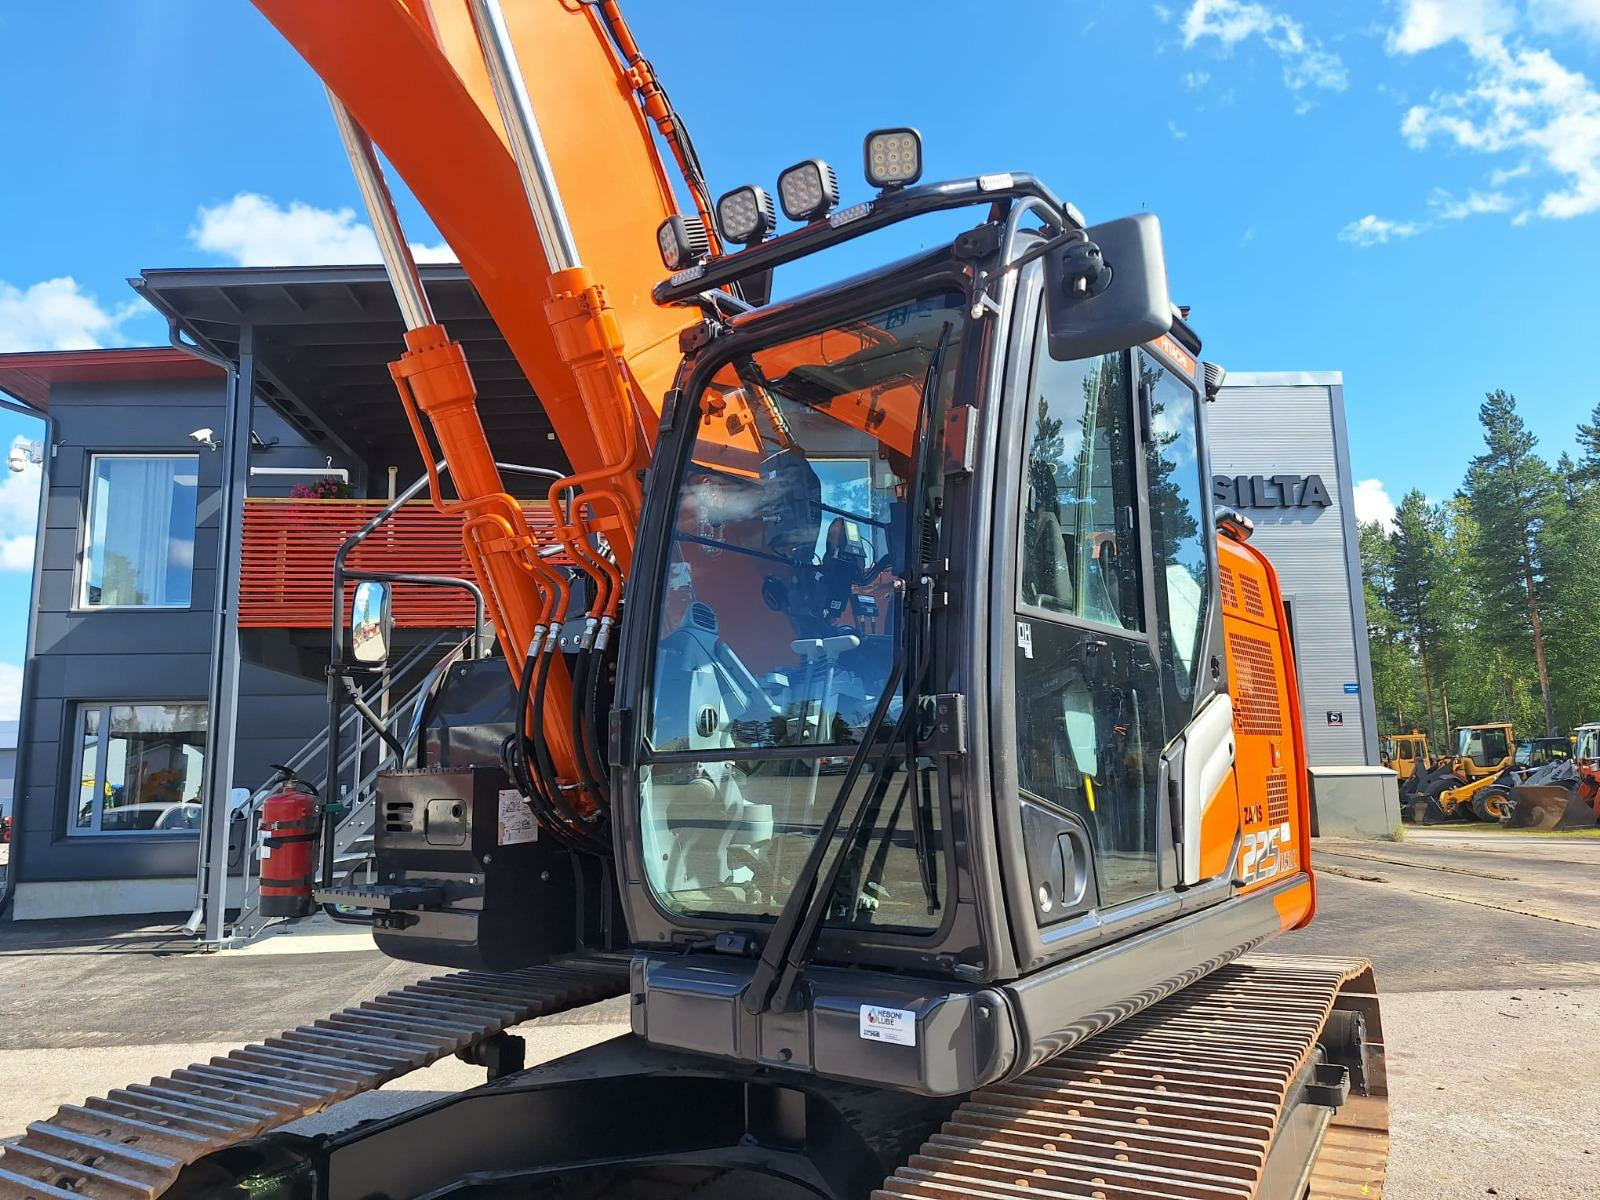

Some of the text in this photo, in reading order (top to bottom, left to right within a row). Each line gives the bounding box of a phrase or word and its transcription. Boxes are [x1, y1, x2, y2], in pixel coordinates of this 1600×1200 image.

[1161, 336, 1188, 368] HITACHI
[1213, 475, 1333, 507] SILTA
[1243, 828, 1280, 886] 225
